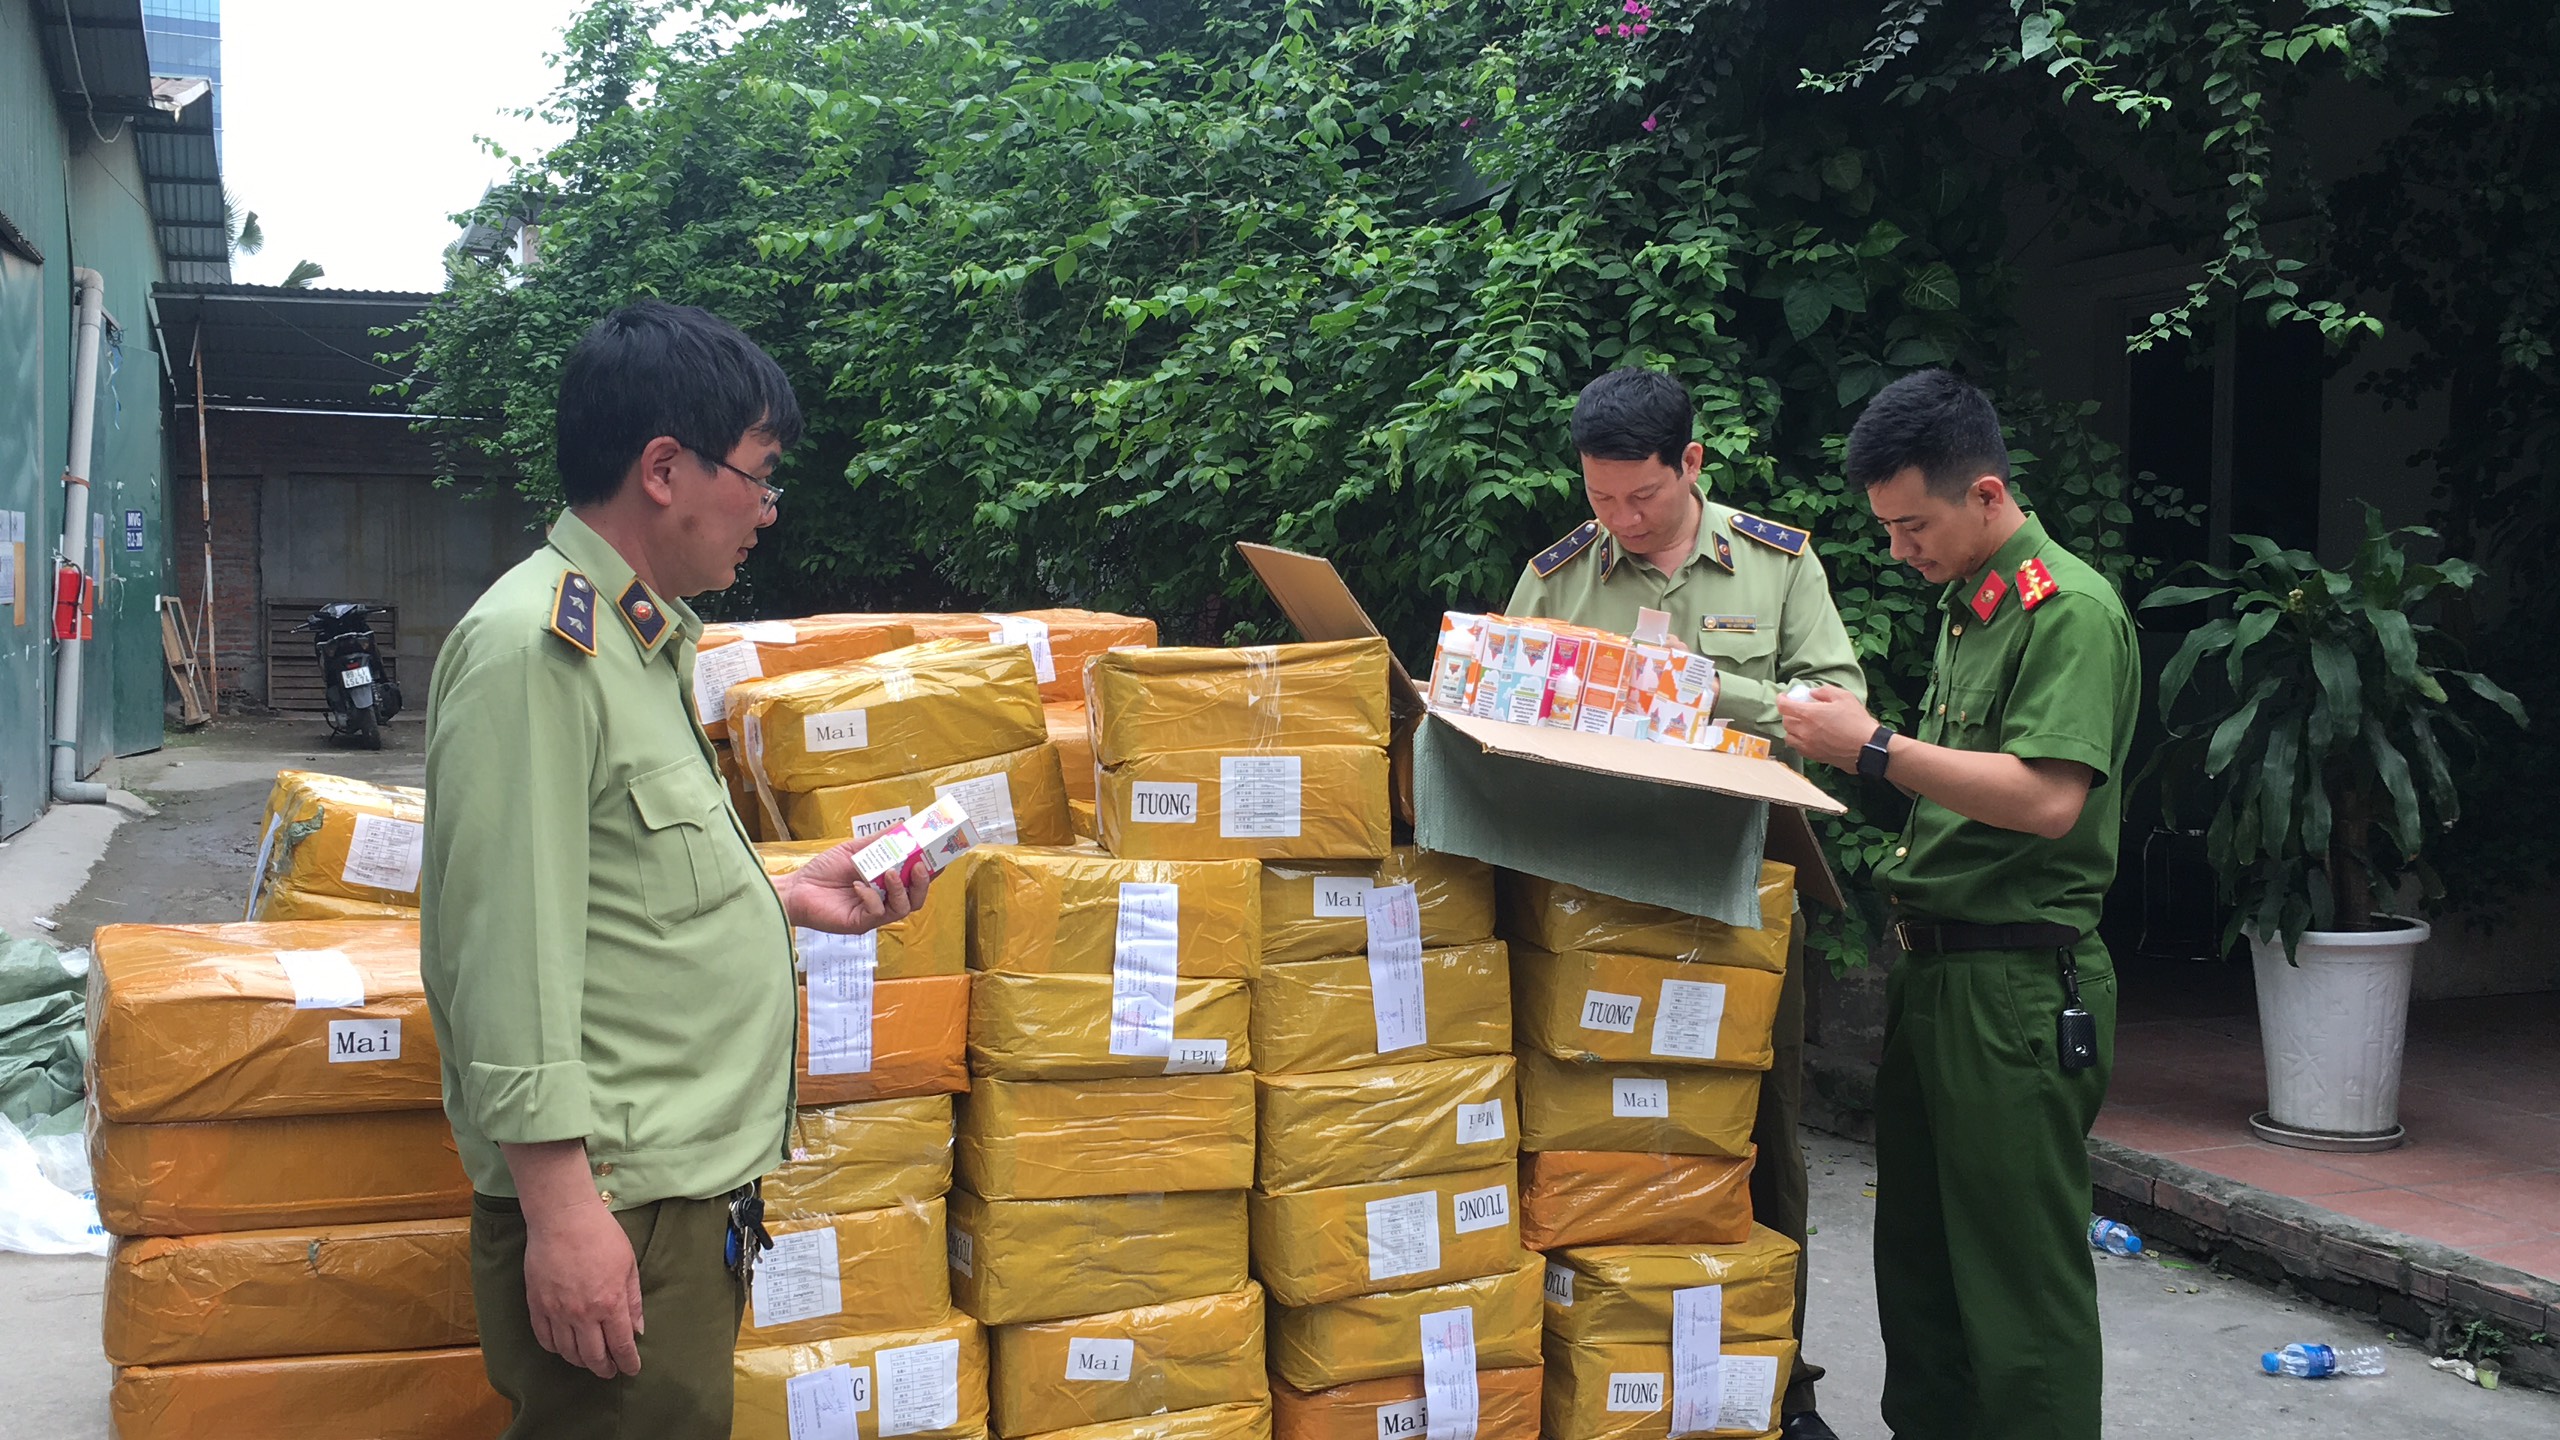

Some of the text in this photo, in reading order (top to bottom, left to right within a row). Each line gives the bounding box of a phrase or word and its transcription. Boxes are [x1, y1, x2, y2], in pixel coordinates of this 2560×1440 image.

[816, 722, 857, 742] Mai
[1137, 792, 1191, 816] TUONG
[857, 816, 906, 836] TUO
[1325, 891, 1364, 907] Mai
[1588, 1001, 1633, 1026] TUONG
[336, 1029, 392, 1054] Mai
[1180, 1049, 1217, 1065] Mai
[1623, 1092, 1659, 1108] Mai
[1468, 1111, 1495, 1129] Mai
[1459, 1193, 1504, 1222] TUONG
[1545, 1271, 1568, 1298] TUO
[1079, 1353, 1120, 1370] Mai
[1614, 1382, 1659, 1404] TUONG
[1384, 1406, 1428, 1436] Mai
